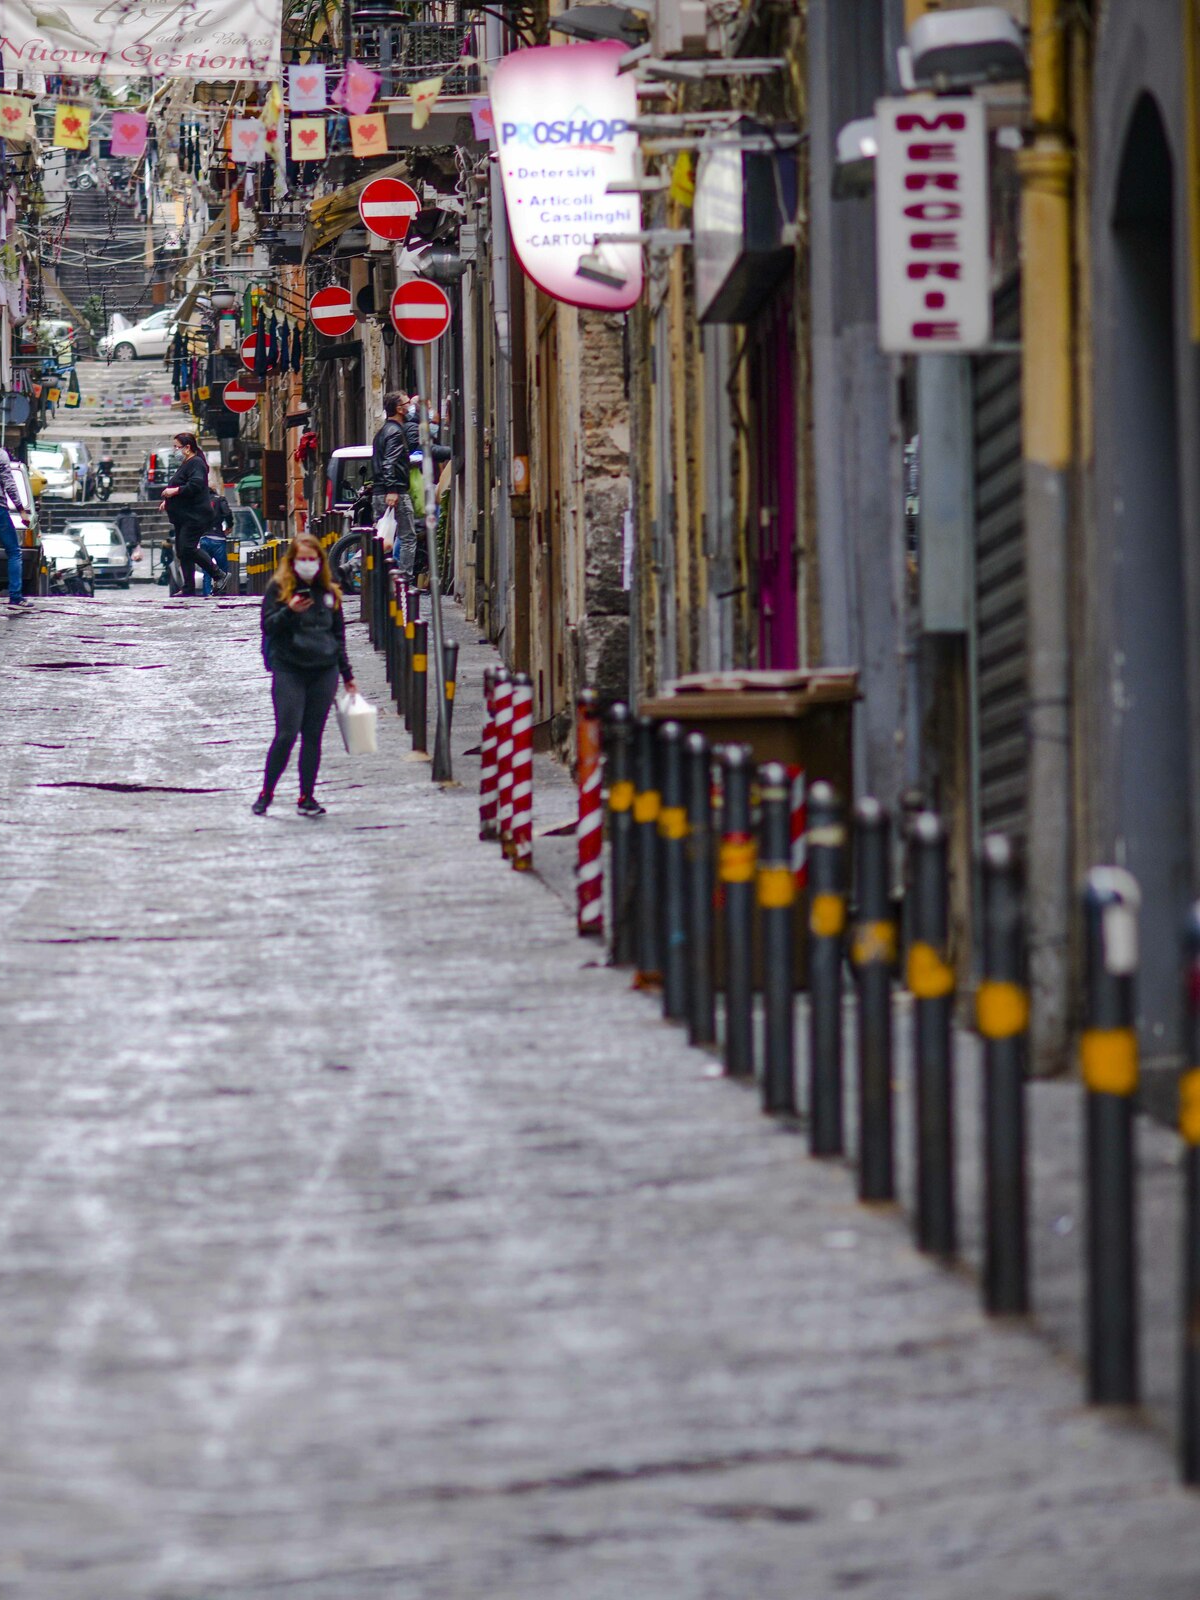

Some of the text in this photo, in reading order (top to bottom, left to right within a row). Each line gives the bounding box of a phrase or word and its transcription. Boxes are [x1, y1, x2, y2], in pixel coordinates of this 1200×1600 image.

[0, 38, 268, 71] Nuova Gestione
[502, 119, 628, 147] PROSHOP
[518, 166, 596, 179] Detersivi
[529, 194, 594, 207] Articoli
[540, 209, 631, 224] Casalinghi
[896, 113, 966, 341] MERCERIE
